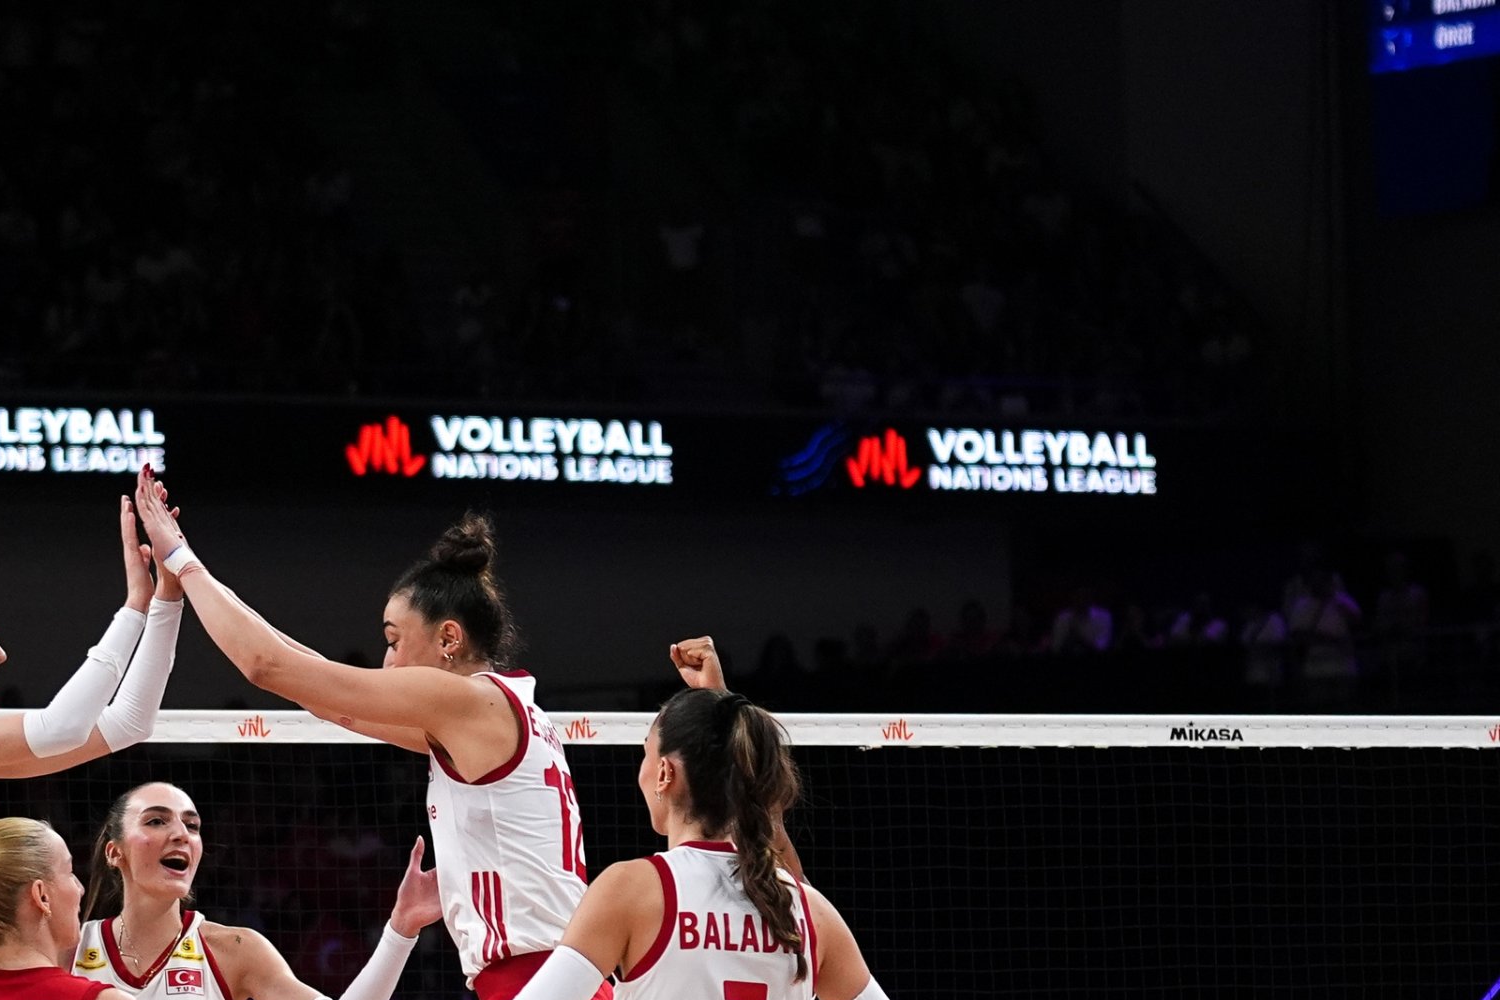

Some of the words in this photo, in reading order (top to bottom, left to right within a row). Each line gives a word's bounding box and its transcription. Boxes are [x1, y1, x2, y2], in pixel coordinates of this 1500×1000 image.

[431, 415, 673, 457] VOLLEYBALL
[928, 429, 1157, 468] VOLLEYBALL
[52, 447, 166, 473] LEAGUE
[431, 453, 559, 480] NATIONS
[564, 458, 673, 484] LEAGUE
[928, 466, 1049, 491] NATIONS
[1054, 469, 1157, 495] LEAGUE
